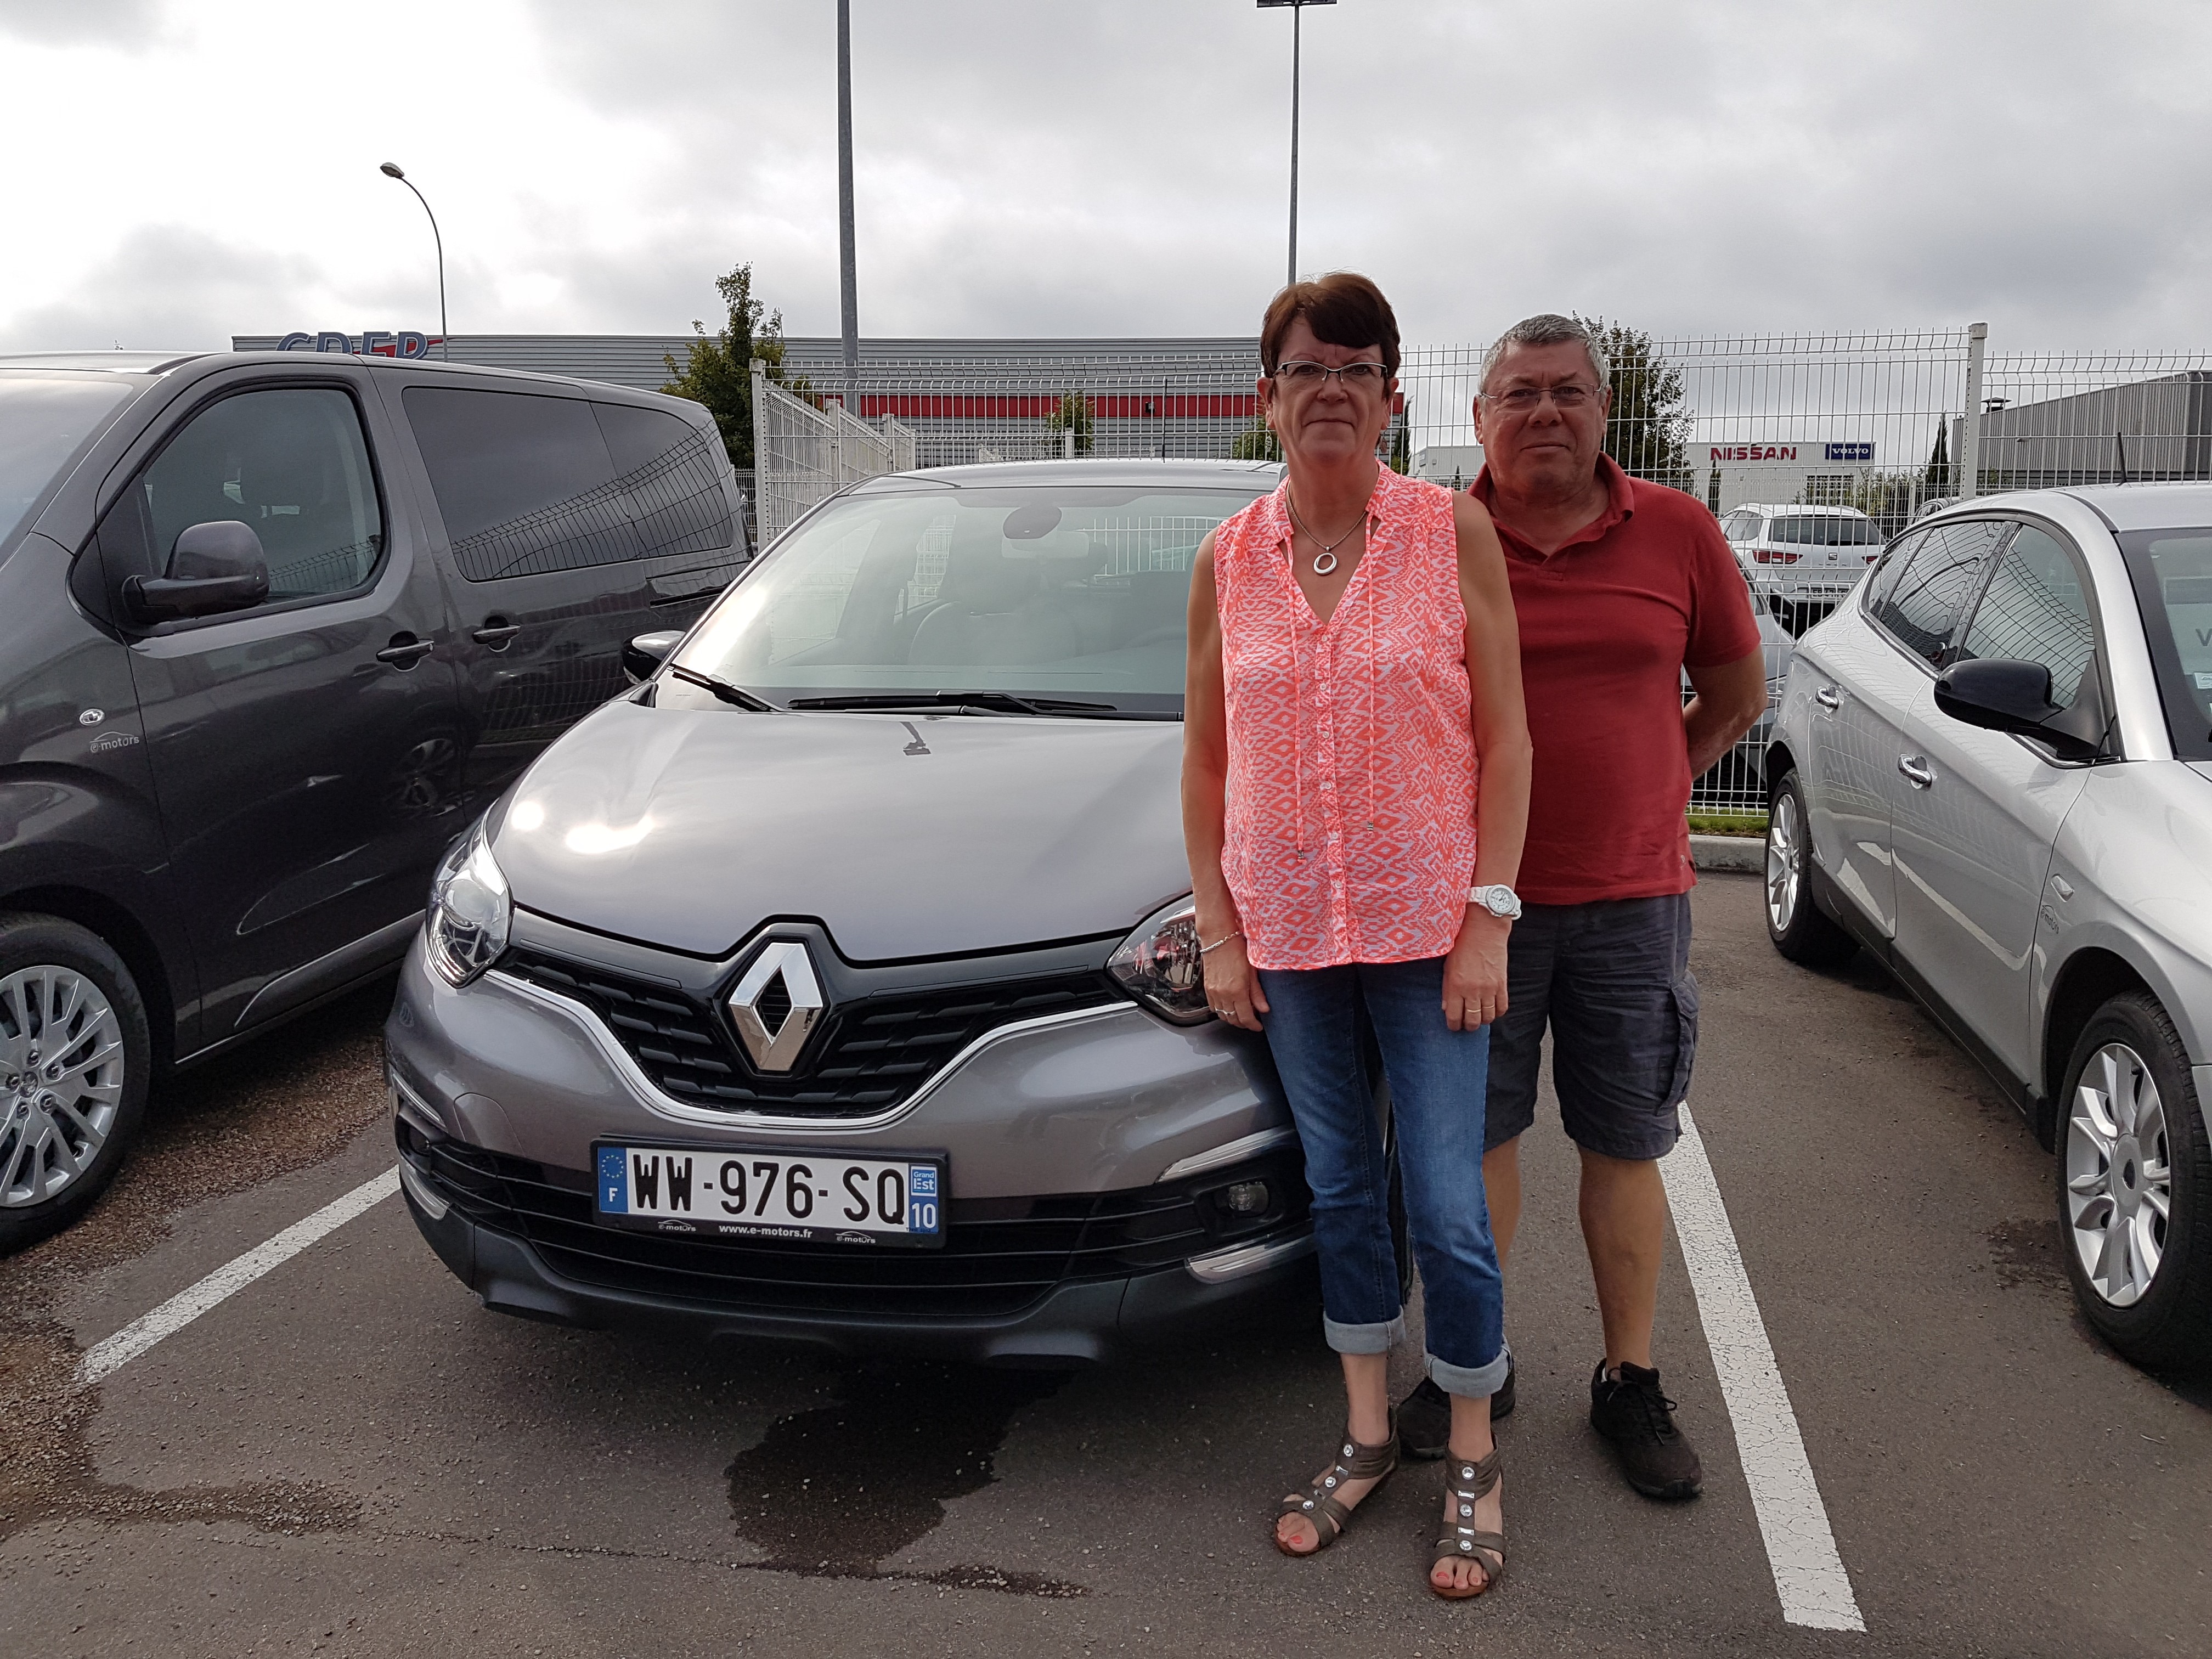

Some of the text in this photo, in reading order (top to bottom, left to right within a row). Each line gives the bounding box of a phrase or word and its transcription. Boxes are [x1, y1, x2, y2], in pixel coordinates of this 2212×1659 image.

[1710, 447, 1797, 460] NISSAN
[913, 1178, 934, 1190] Est
[609, 1187, 618, 1202] F
[912, 1203, 936, 1228] 10
[719, 1225, 812, 1238] www.e-motors.fr
